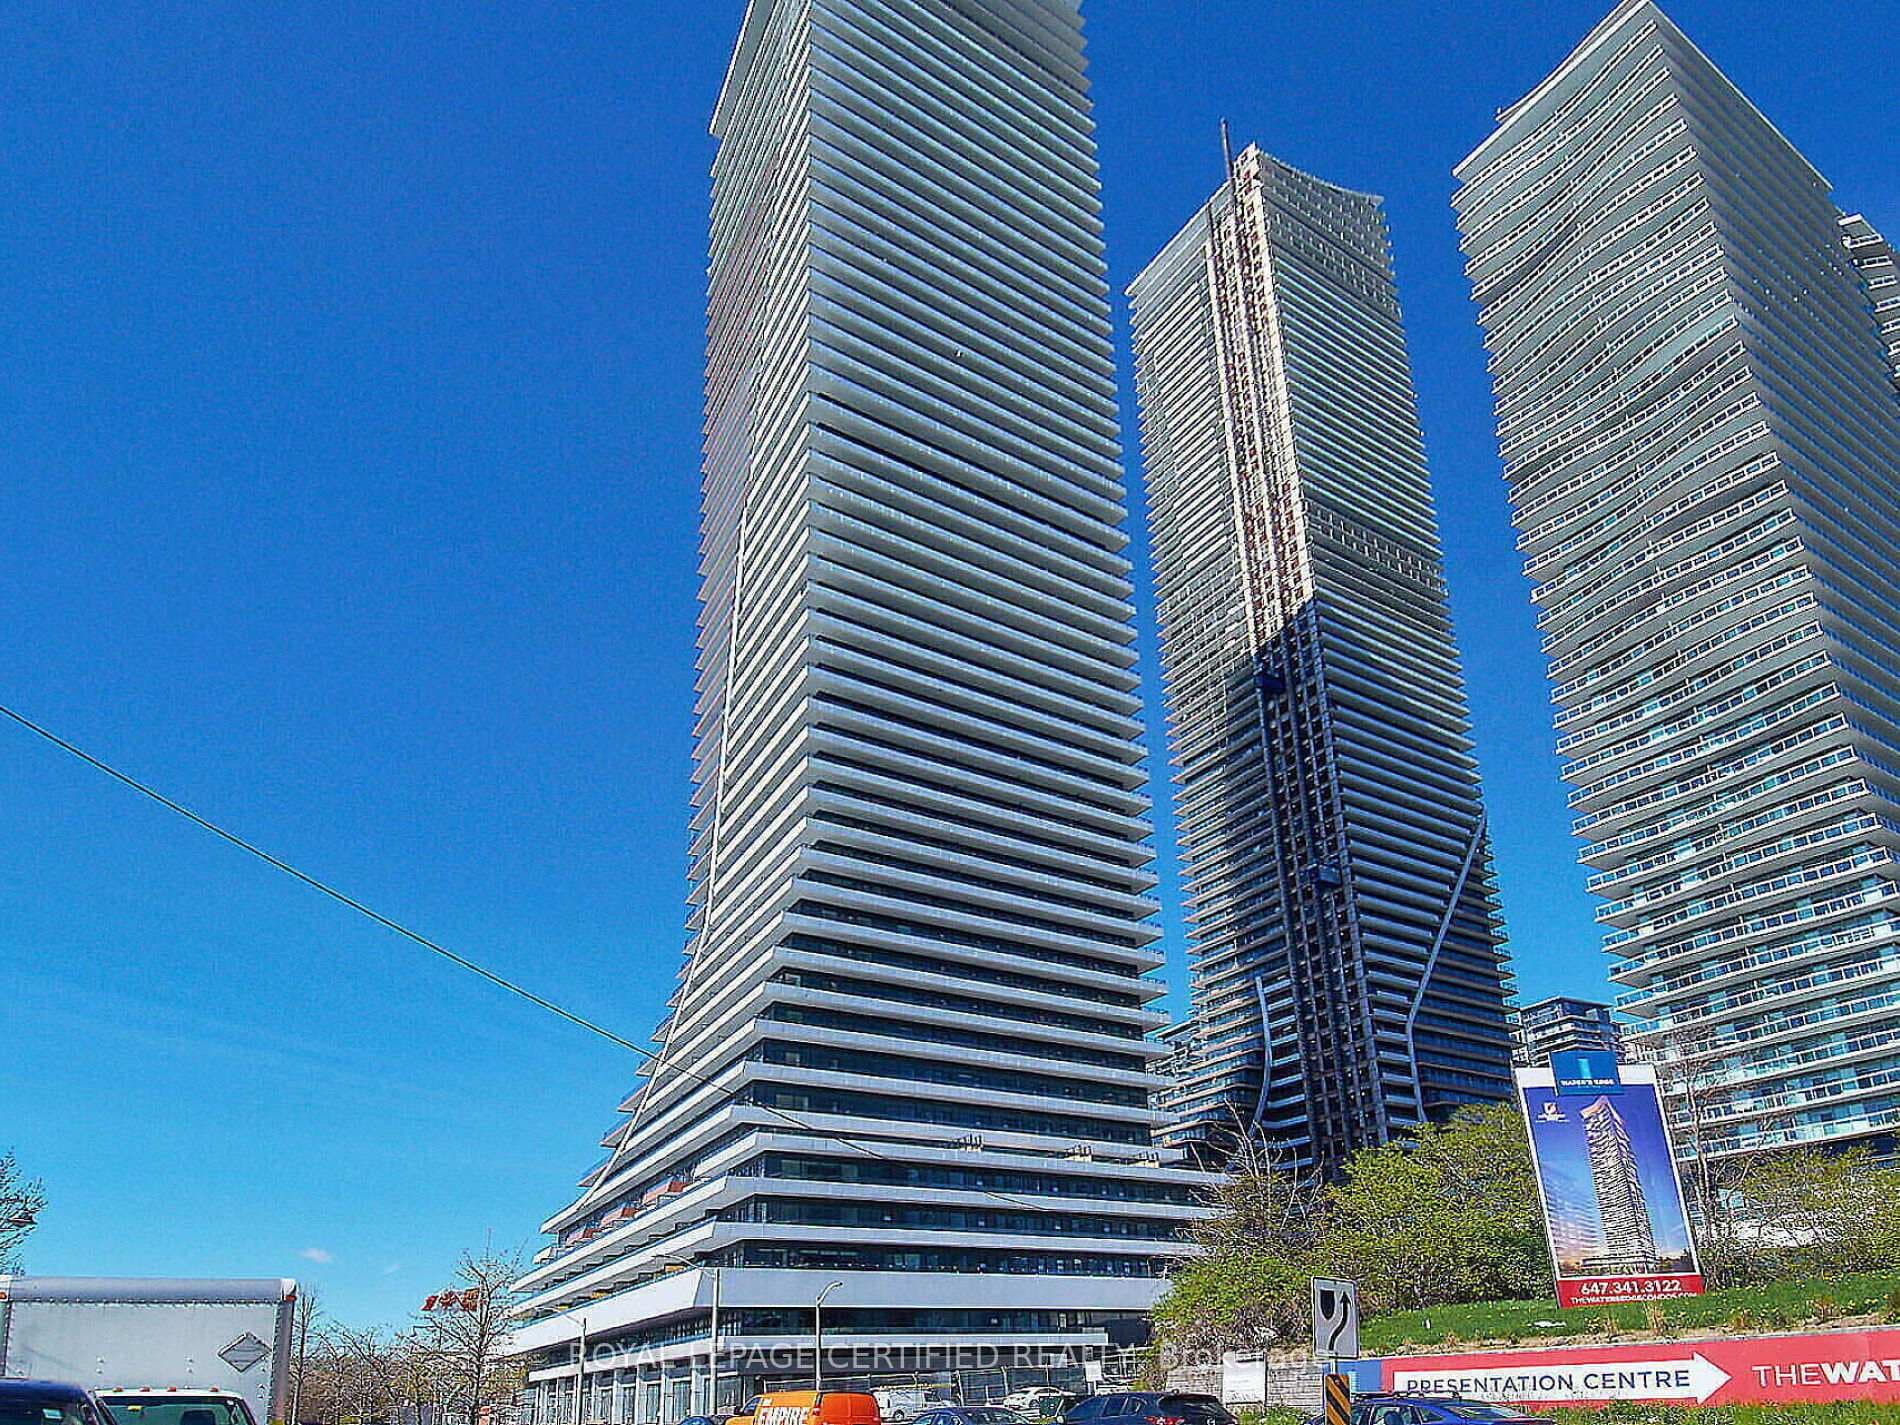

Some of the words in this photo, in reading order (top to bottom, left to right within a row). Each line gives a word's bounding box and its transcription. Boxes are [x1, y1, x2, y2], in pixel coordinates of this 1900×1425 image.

[1581, 1279, 1682, 1296] 647.341.3122
[1407, 1374, 1573, 1393] PRESENTATION
[1583, 1370, 1690, 1389] CENTRE
